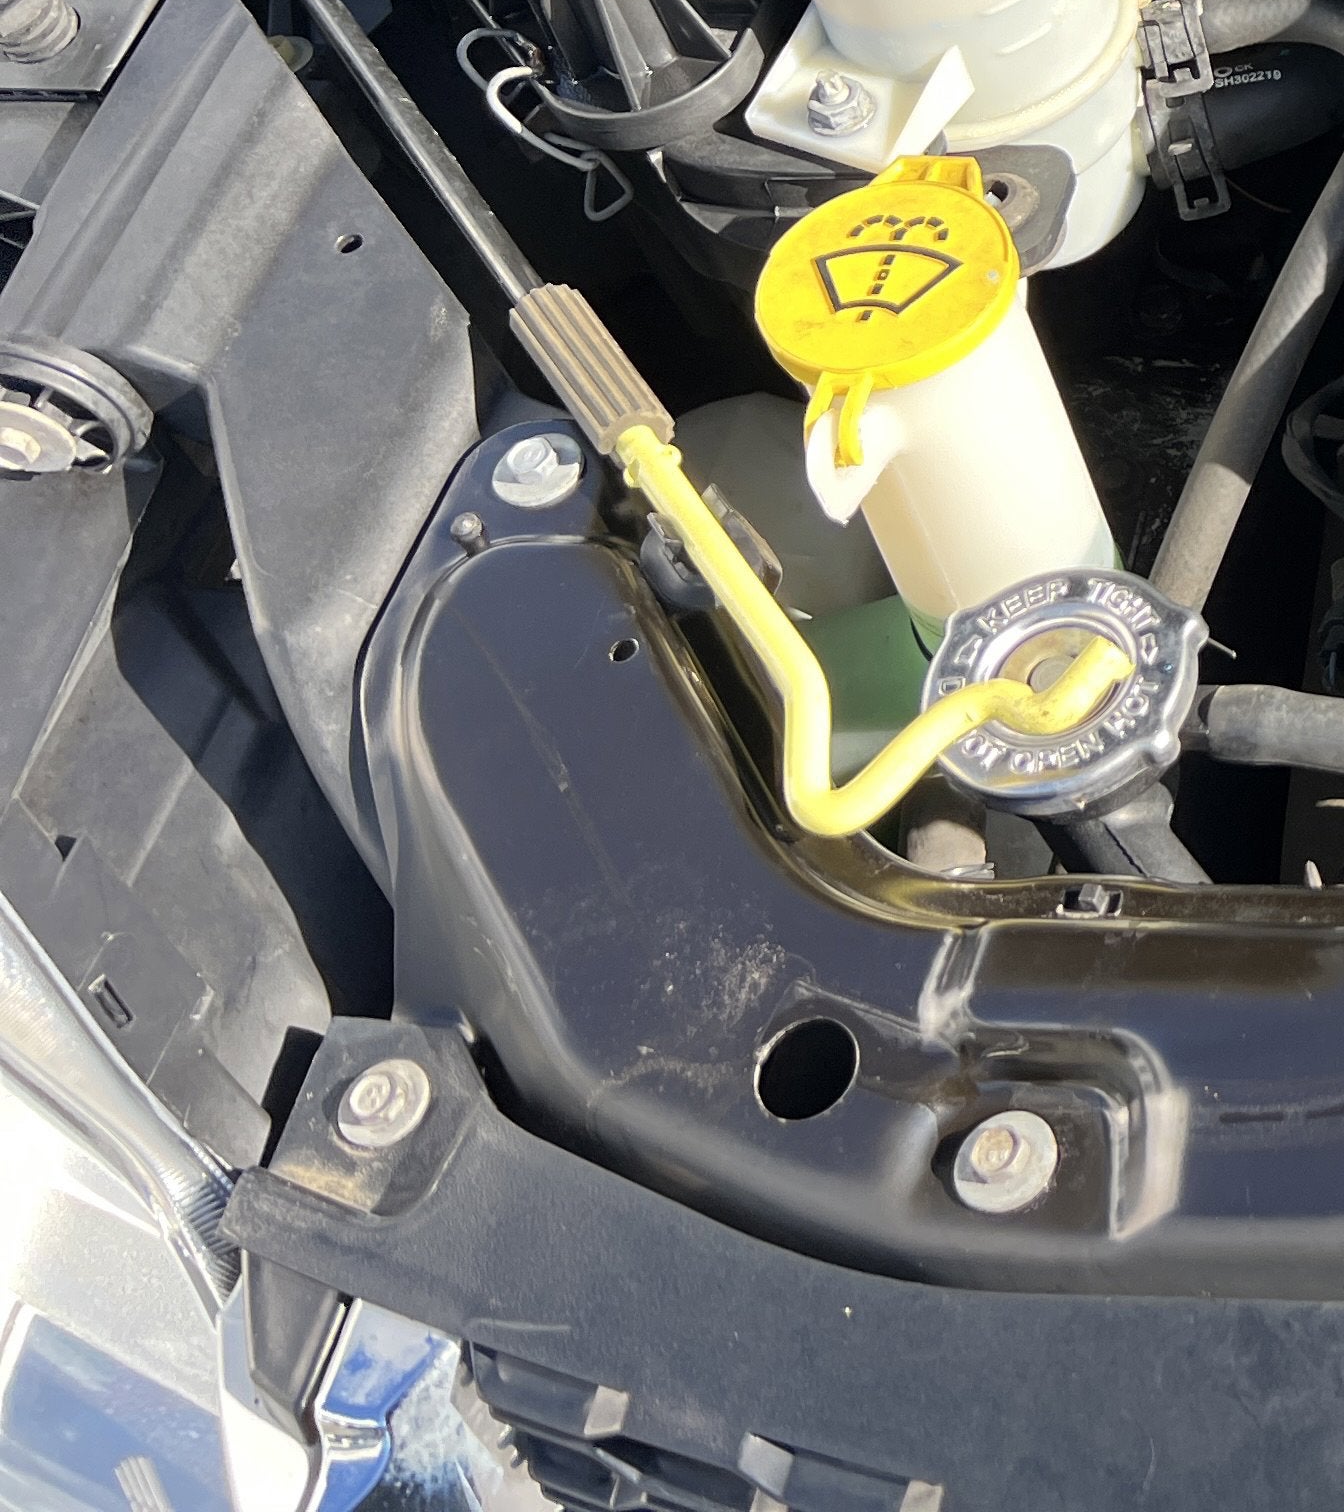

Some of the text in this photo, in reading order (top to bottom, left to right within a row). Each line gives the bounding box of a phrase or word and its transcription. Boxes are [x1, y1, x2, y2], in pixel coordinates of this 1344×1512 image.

[977, 577, 1162, 634] KEEP TIGHT
[1008, 732, 1106, 773] OPEN
[1103, 676, 1159, 738] HOT
